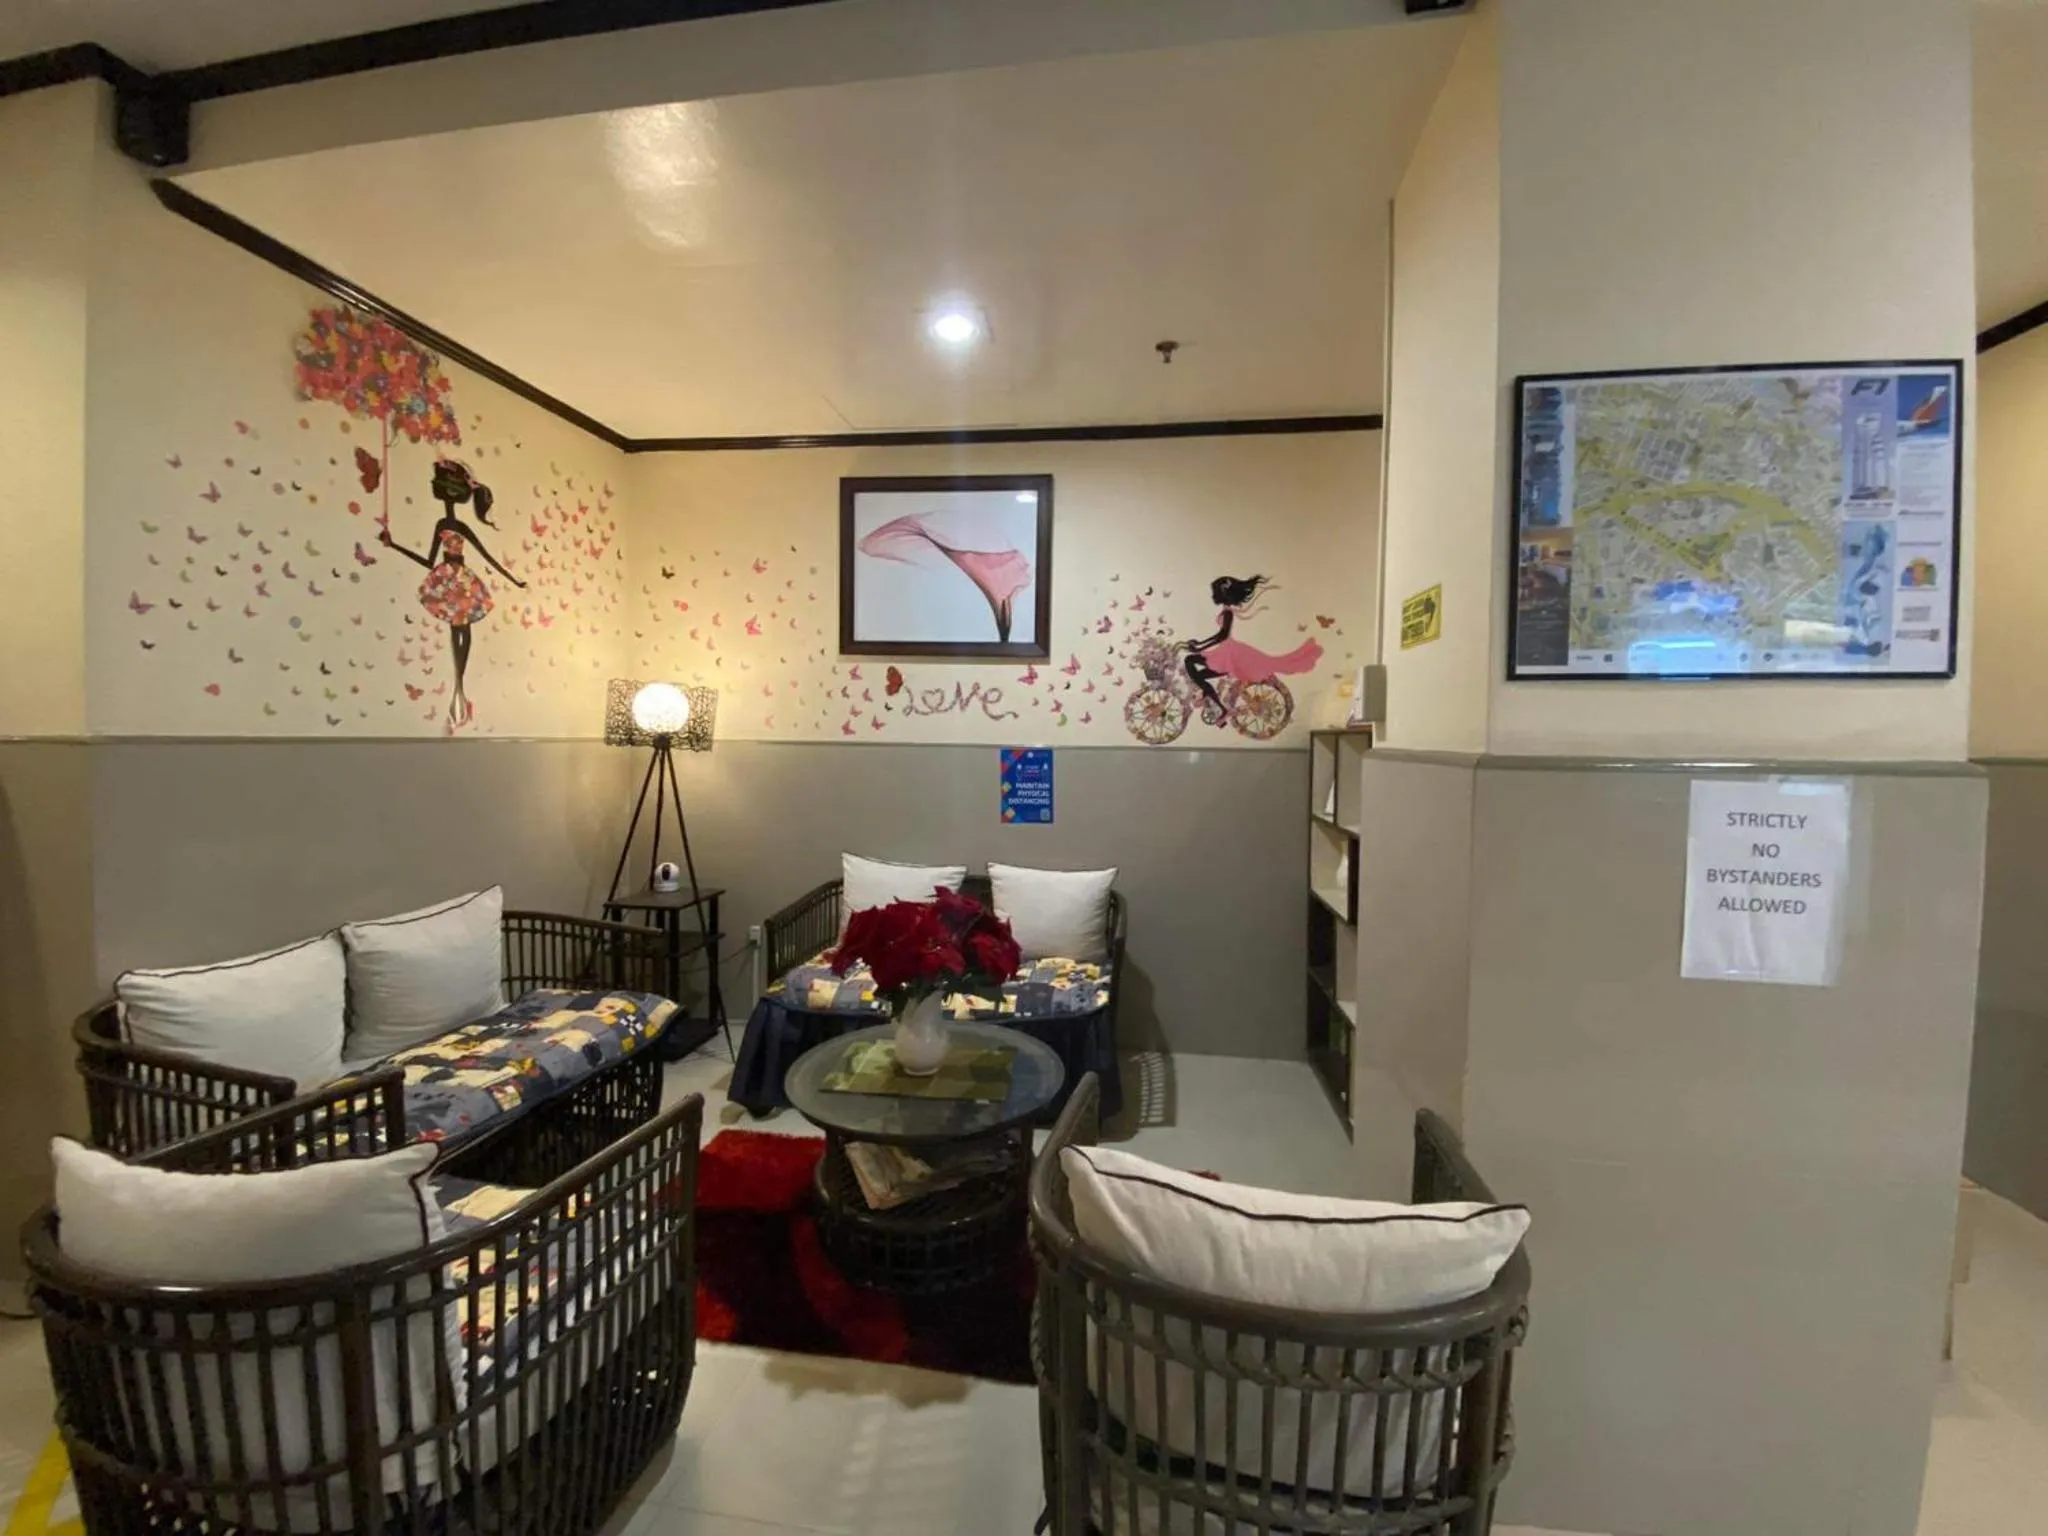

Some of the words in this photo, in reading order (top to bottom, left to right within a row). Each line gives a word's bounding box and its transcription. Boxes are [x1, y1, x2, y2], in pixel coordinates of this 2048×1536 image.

[1726, 811, 1808, 829] STRICTLY
[1750, 843, 1780, 858] NO
[1706, 868, 1822, 888] BYSTANDERS
[1718, 896, 1807, 915] ALLOWED
